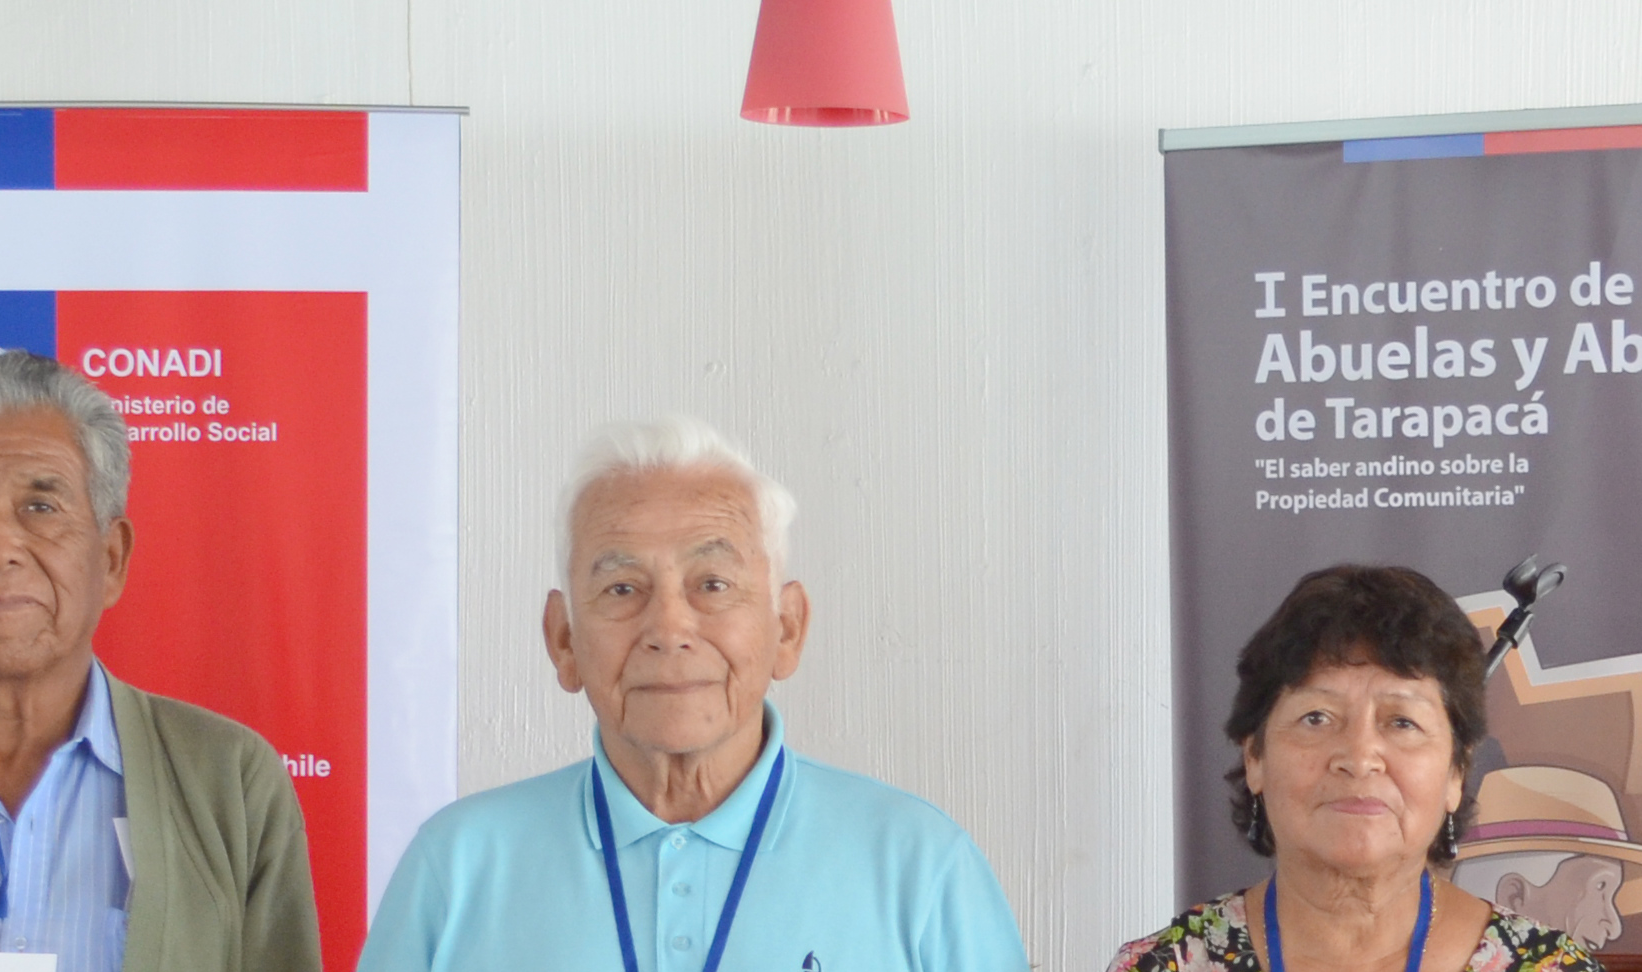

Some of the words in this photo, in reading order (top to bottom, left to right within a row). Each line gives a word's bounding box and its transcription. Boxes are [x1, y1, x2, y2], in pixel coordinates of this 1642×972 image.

[1255, 272, 1286, 318] I
[1302, 271, 1557, 317] Encuentro
[1570, 261, 1634, 306] de
[83, 348, 222, 377] CONADI
[1255, 325, 1497, 383] Abuelas
[1512, 336, 1548, 391] y
[111, 396, 195, 414] nisterio
[203, 396, 229, 414] de
[1255, 398, 1316, 442] de
[1325, 390, 1549, 448] Tarapacá
[127, 423, 201, 441] arrollo
[208, 422, 276, 441] Social
[1255, 458, 1285, 479] "El
[1290, 457, 1350, 478] saber
[1355, 455, 1435, 476] andino
[1440, 455, 1504, 475] sobre
[1509, 452, 1529, 473] la
[1255, 488, 1369, 514] Propiedad
[1374, 485, 1525, 508] Comunitaria"
[283, 754, 331, 777] hile
